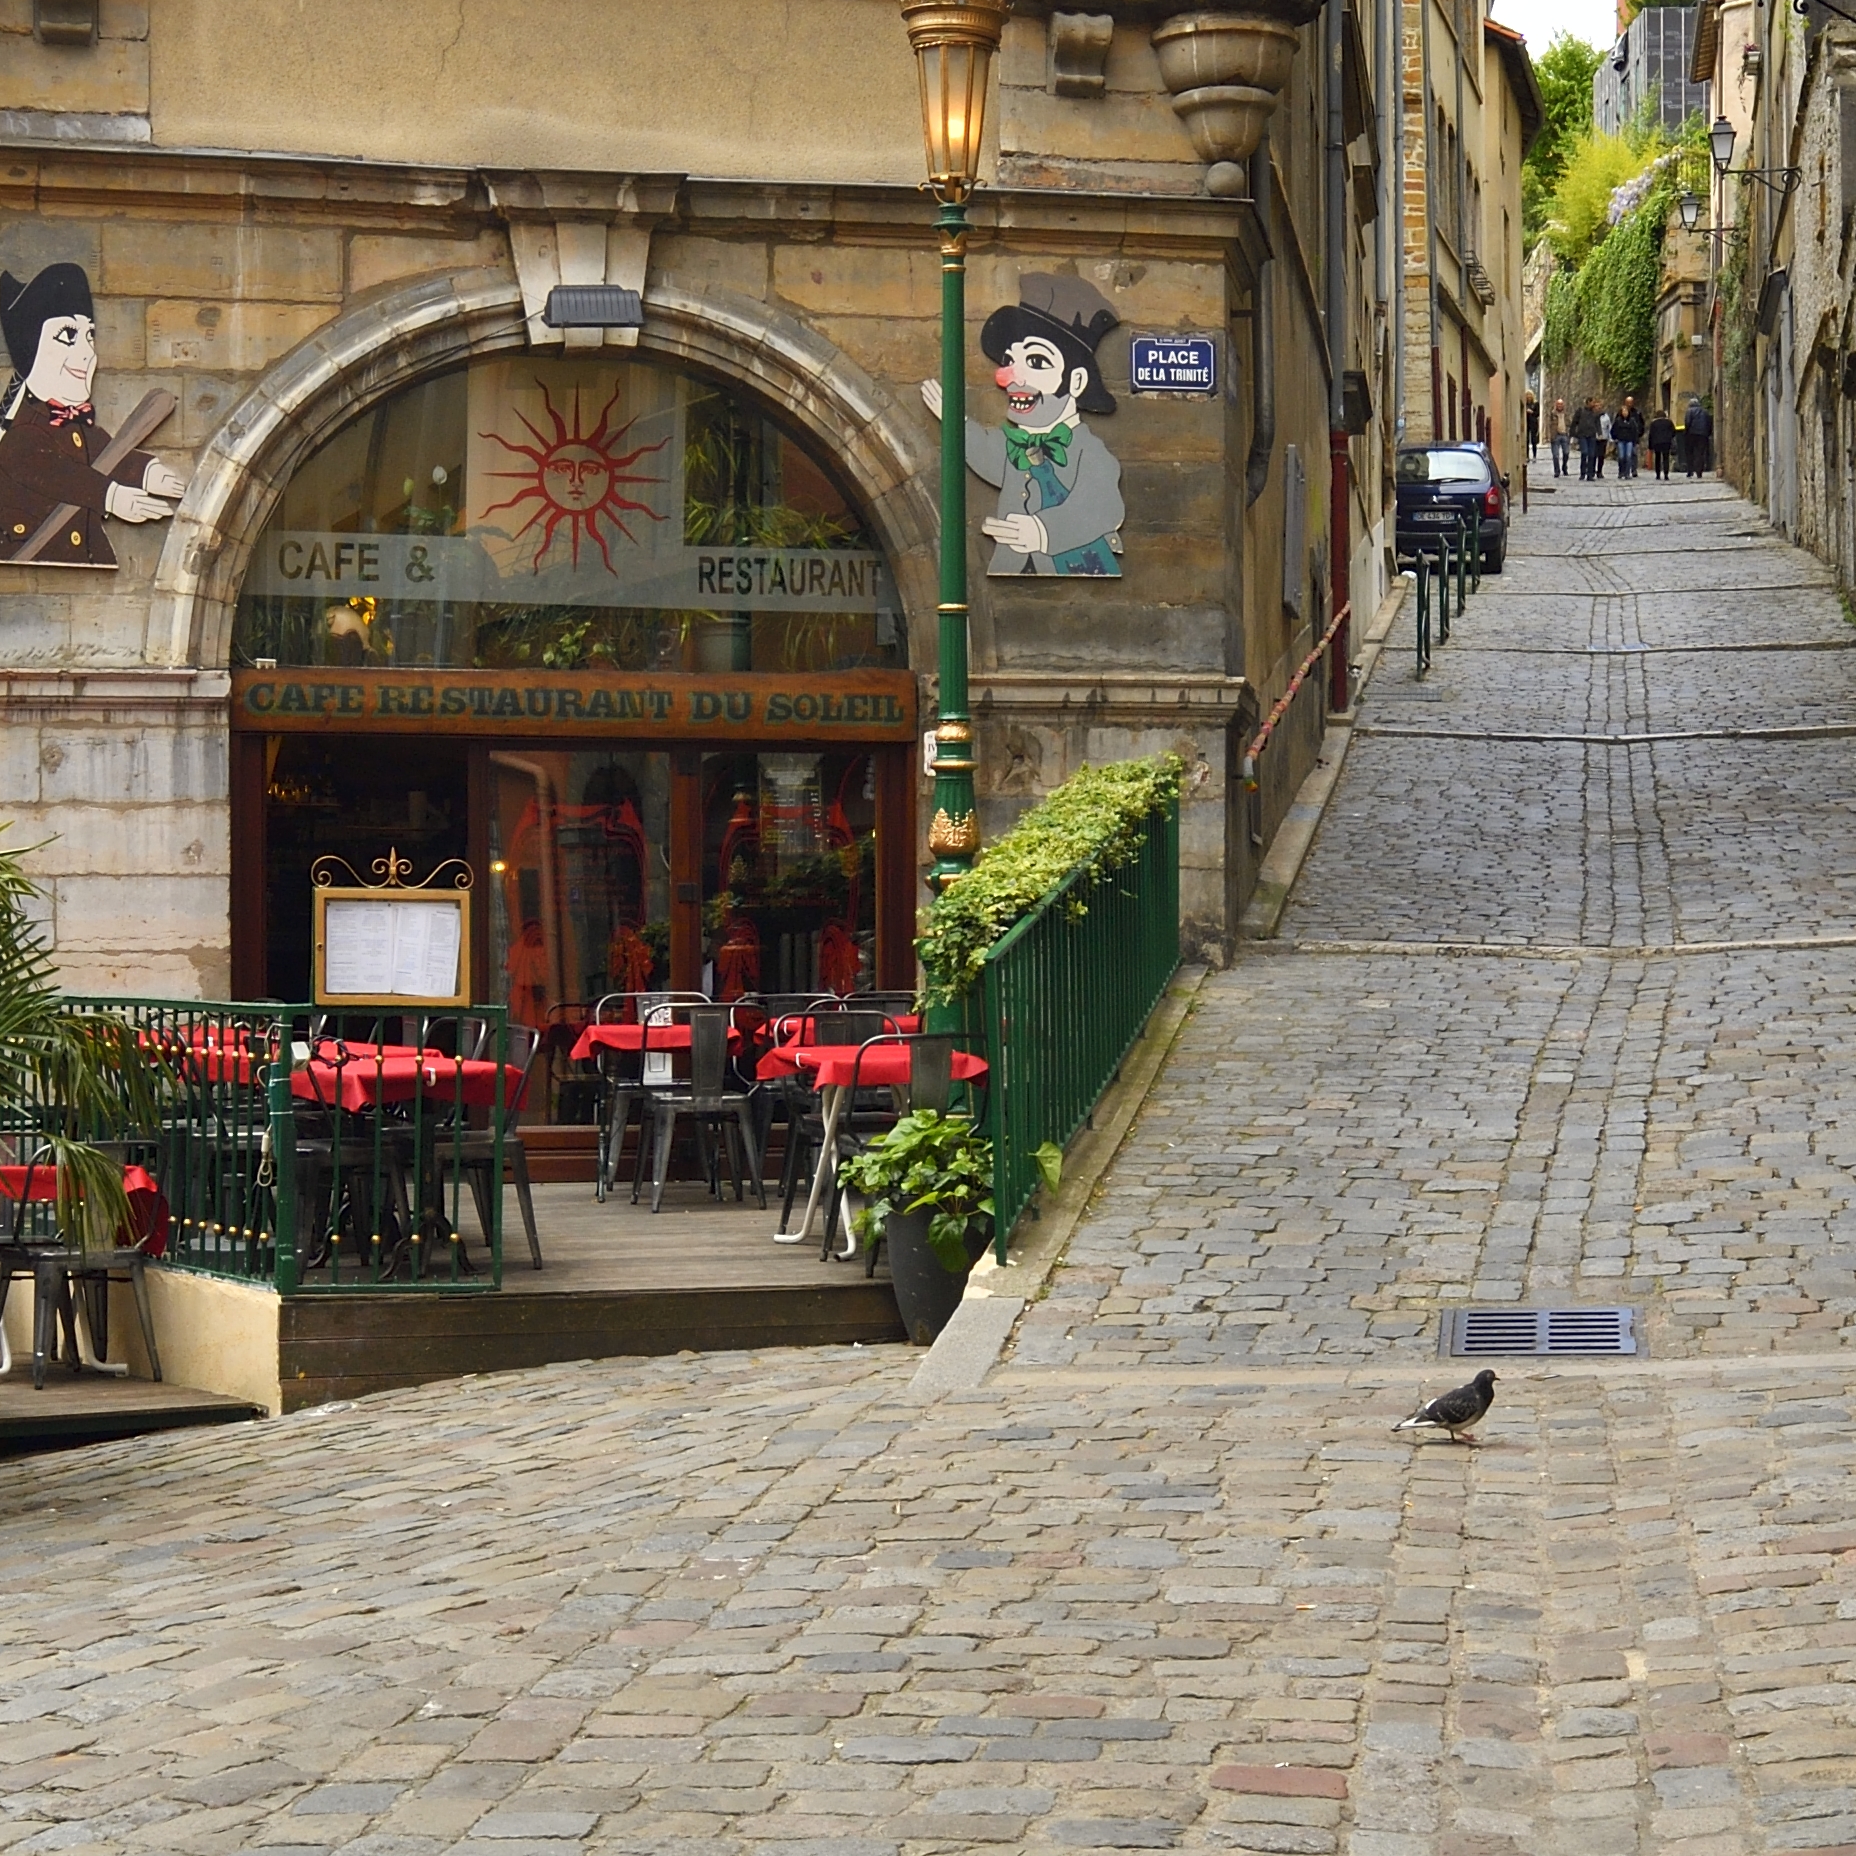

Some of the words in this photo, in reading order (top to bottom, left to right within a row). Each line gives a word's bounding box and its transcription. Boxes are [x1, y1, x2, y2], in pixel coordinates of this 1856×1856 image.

[1147, 350, 1200, 365] PLACE
[1137, 367, 1151, 381] DE
[1152, 367, 1166, 382] LA
[1169, 366, 1209, 382] TRINITÉ
[277, 539, 380, 582] CAFE
[405, 544, 436, 583] &
[697, 555, 882, 598] RESTAURANT
[244, 682, 365, 720] CAFE
[372, 683, 673, 723] RESTAURANT
[688, 690, 752, 724] DU
[763, 692, 905, 727] SOLEIL
